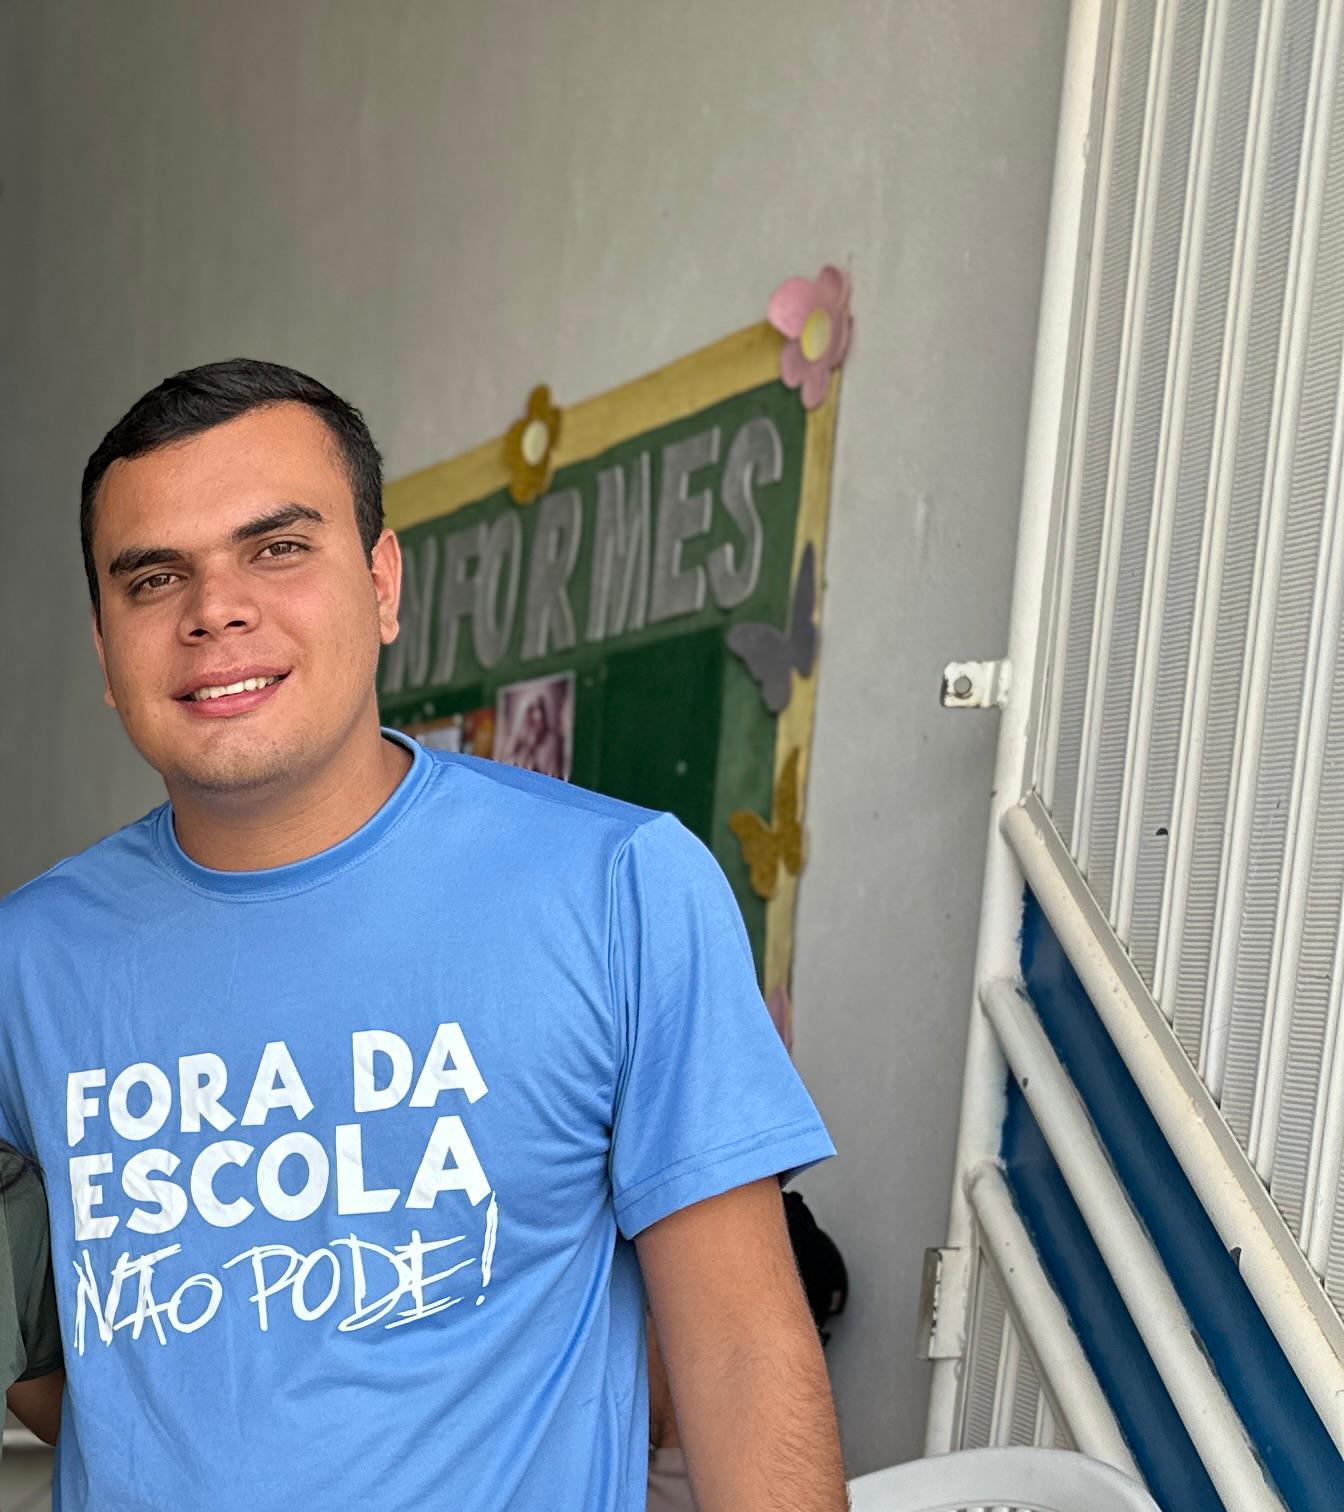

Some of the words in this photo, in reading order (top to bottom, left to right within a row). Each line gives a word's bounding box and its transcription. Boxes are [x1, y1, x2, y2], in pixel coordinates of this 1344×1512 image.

[382, 416, 783, 693] NFORMES
[66, 1040, 315, 1147] FORA
[352, 1022, 489, 1113] DA
[69, 1115, 492, 1241] ESCOLA
[72, 1243, 224, 1357] NÃO
[222, 1190, 498, 1332] PODE!
